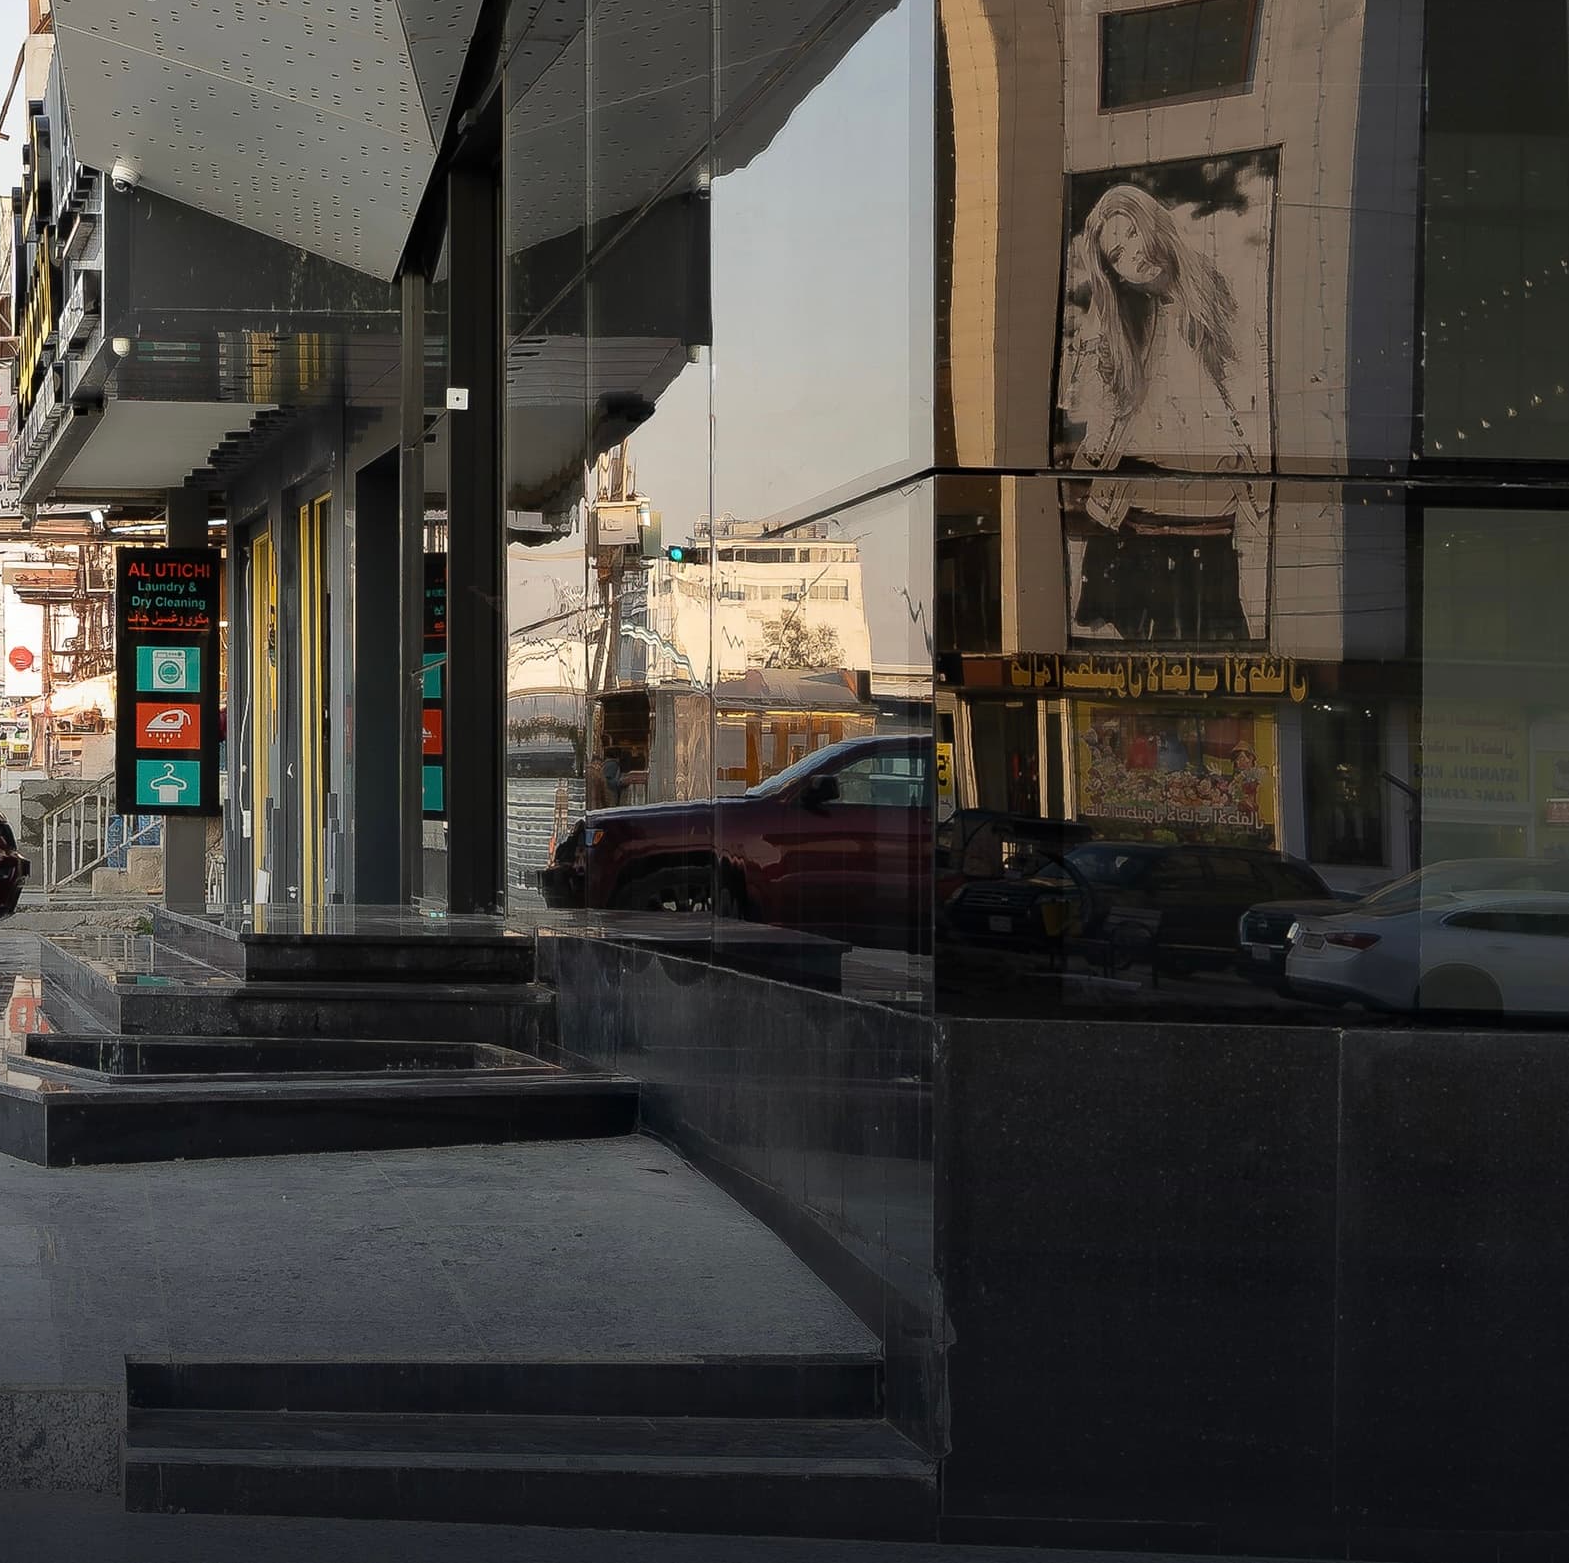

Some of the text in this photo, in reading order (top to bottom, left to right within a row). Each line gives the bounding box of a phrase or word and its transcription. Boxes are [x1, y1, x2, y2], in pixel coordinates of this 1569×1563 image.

[128, 562, 210, 578] AL UTICHI
[137, 581, 197, 594] Laundry &
[132, 596, 206, 611] Dry Cleaning
